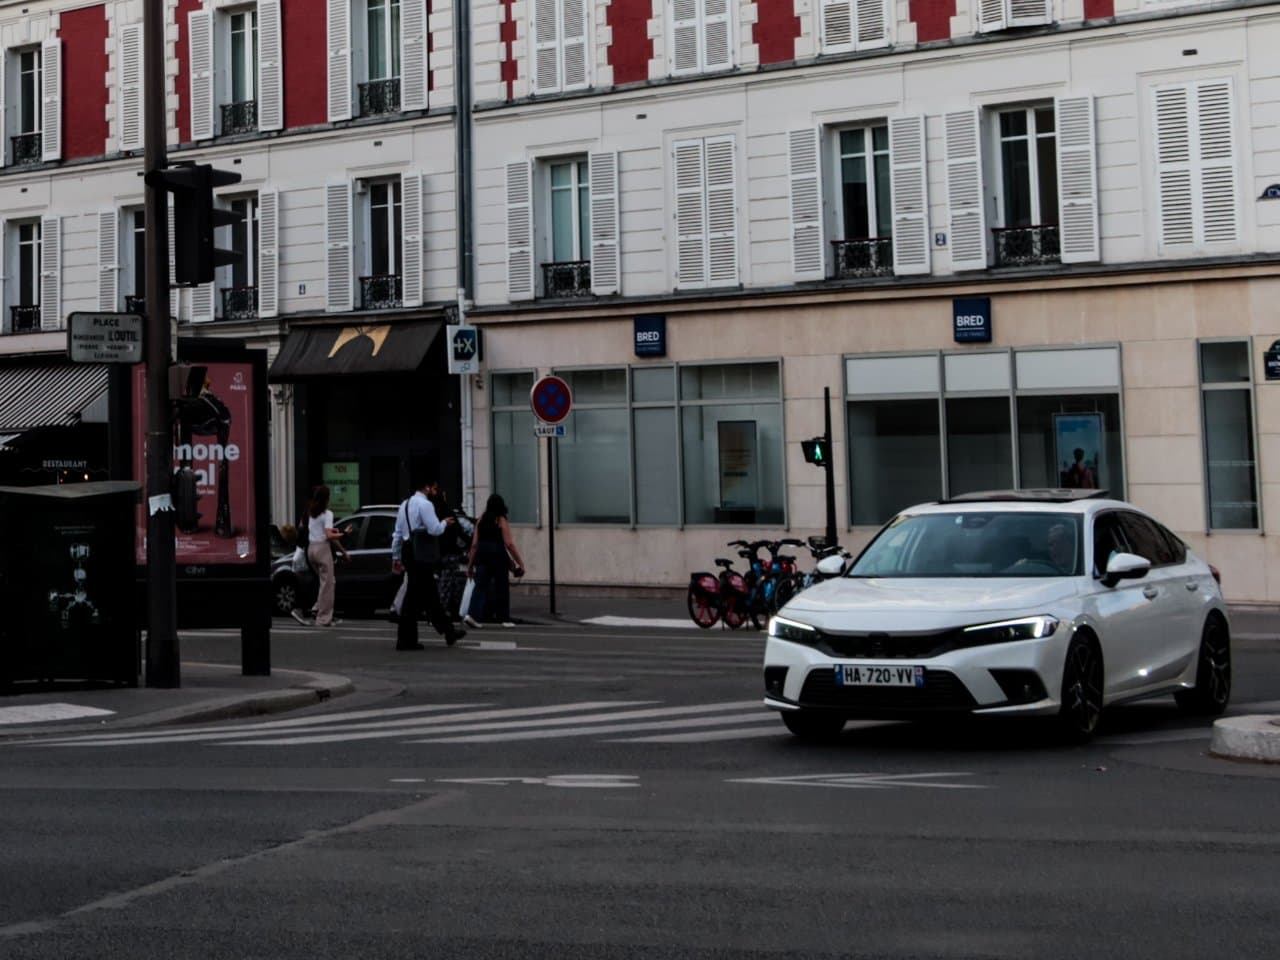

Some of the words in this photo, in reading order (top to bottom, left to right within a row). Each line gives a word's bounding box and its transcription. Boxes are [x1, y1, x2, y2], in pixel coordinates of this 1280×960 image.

[93, 318, 120, 327] PLACE
[956, 315, 984, 326] BRED
[636, 331, 660, 342] BRED
[538, 427, 555, 435] SAUF
[172, 442, 240, 461] mone
[42, 460, 88, 468] RESTAURANT
[845, 668, 912, 683] HA-720-VV
